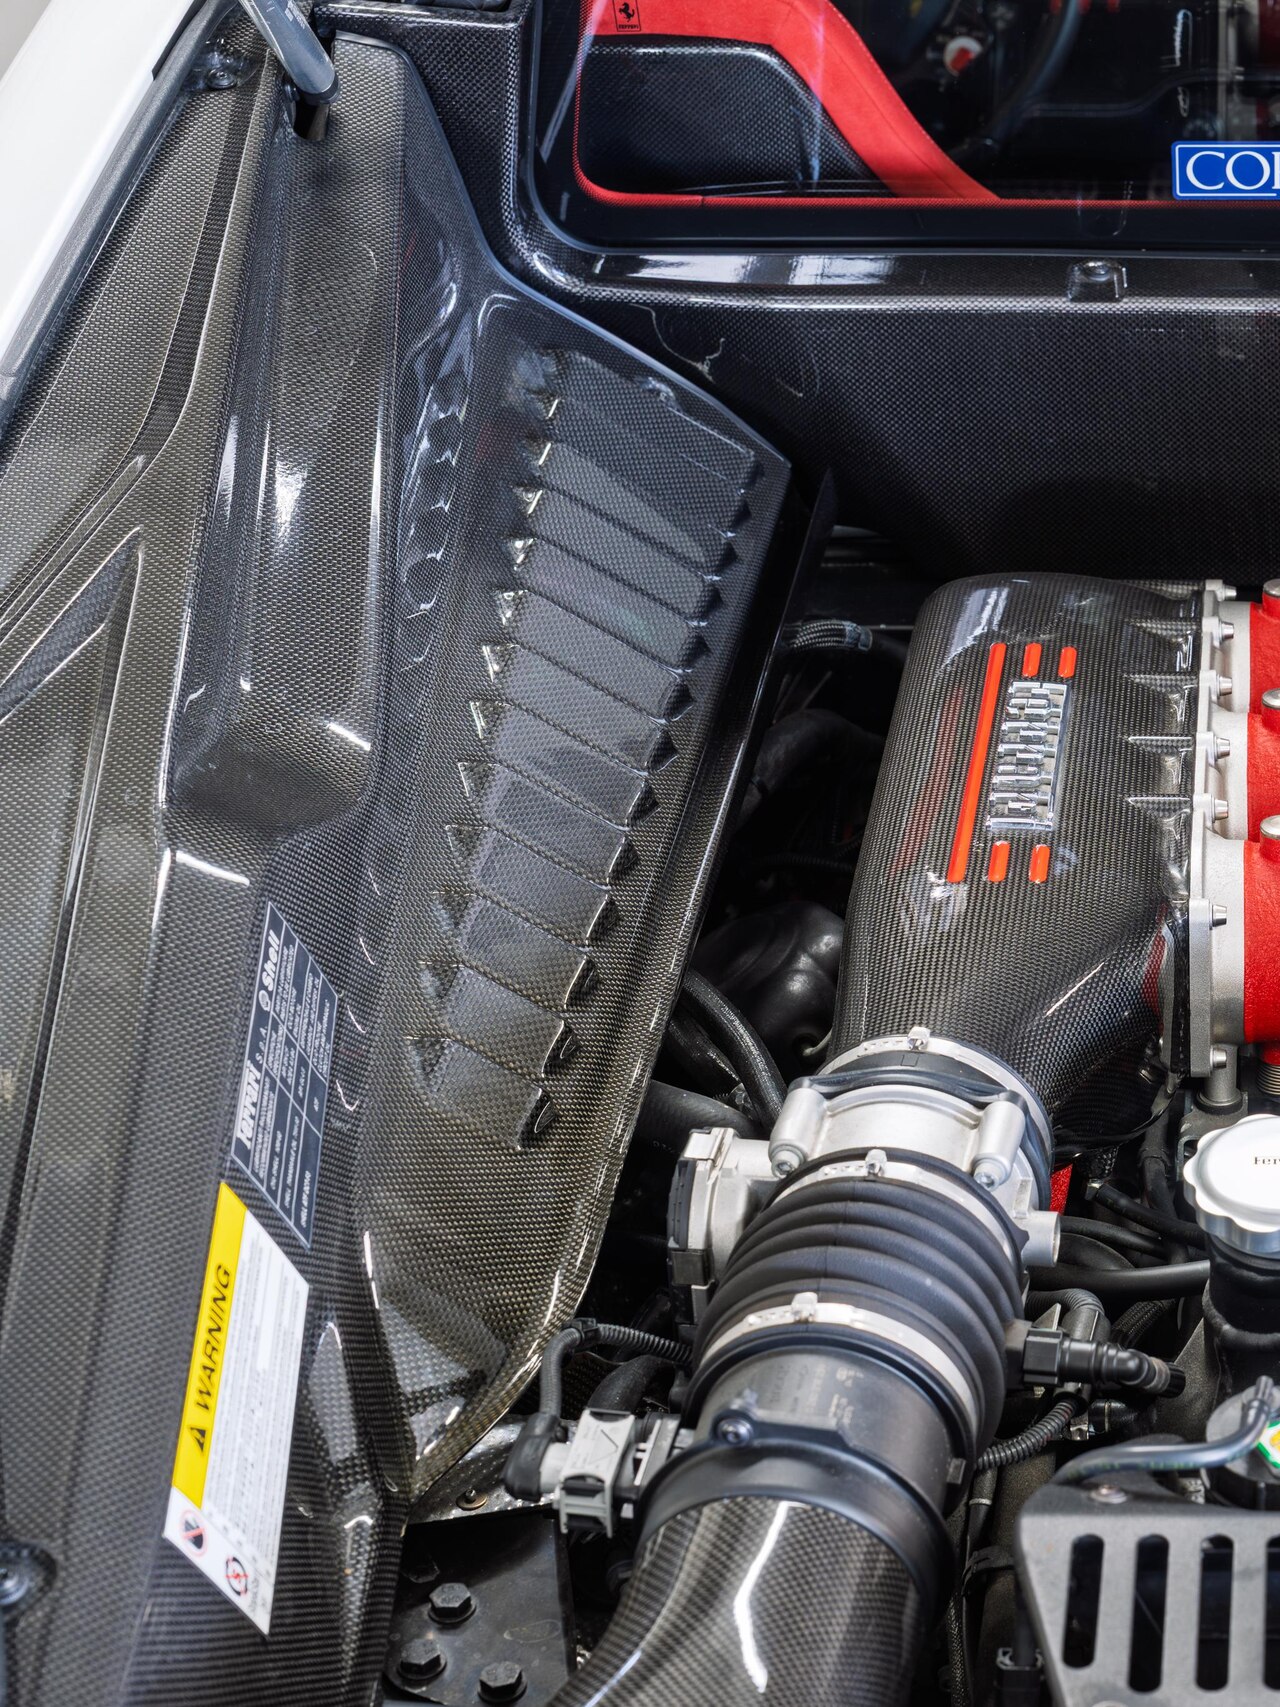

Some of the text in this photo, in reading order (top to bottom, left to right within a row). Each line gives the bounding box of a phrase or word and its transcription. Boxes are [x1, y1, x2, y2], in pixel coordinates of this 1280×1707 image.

[262, 929, 279, 991] Shell
[236, 1060, 261, 1149] Ferrari
[195, 1264, 231, 1411] WARNING
